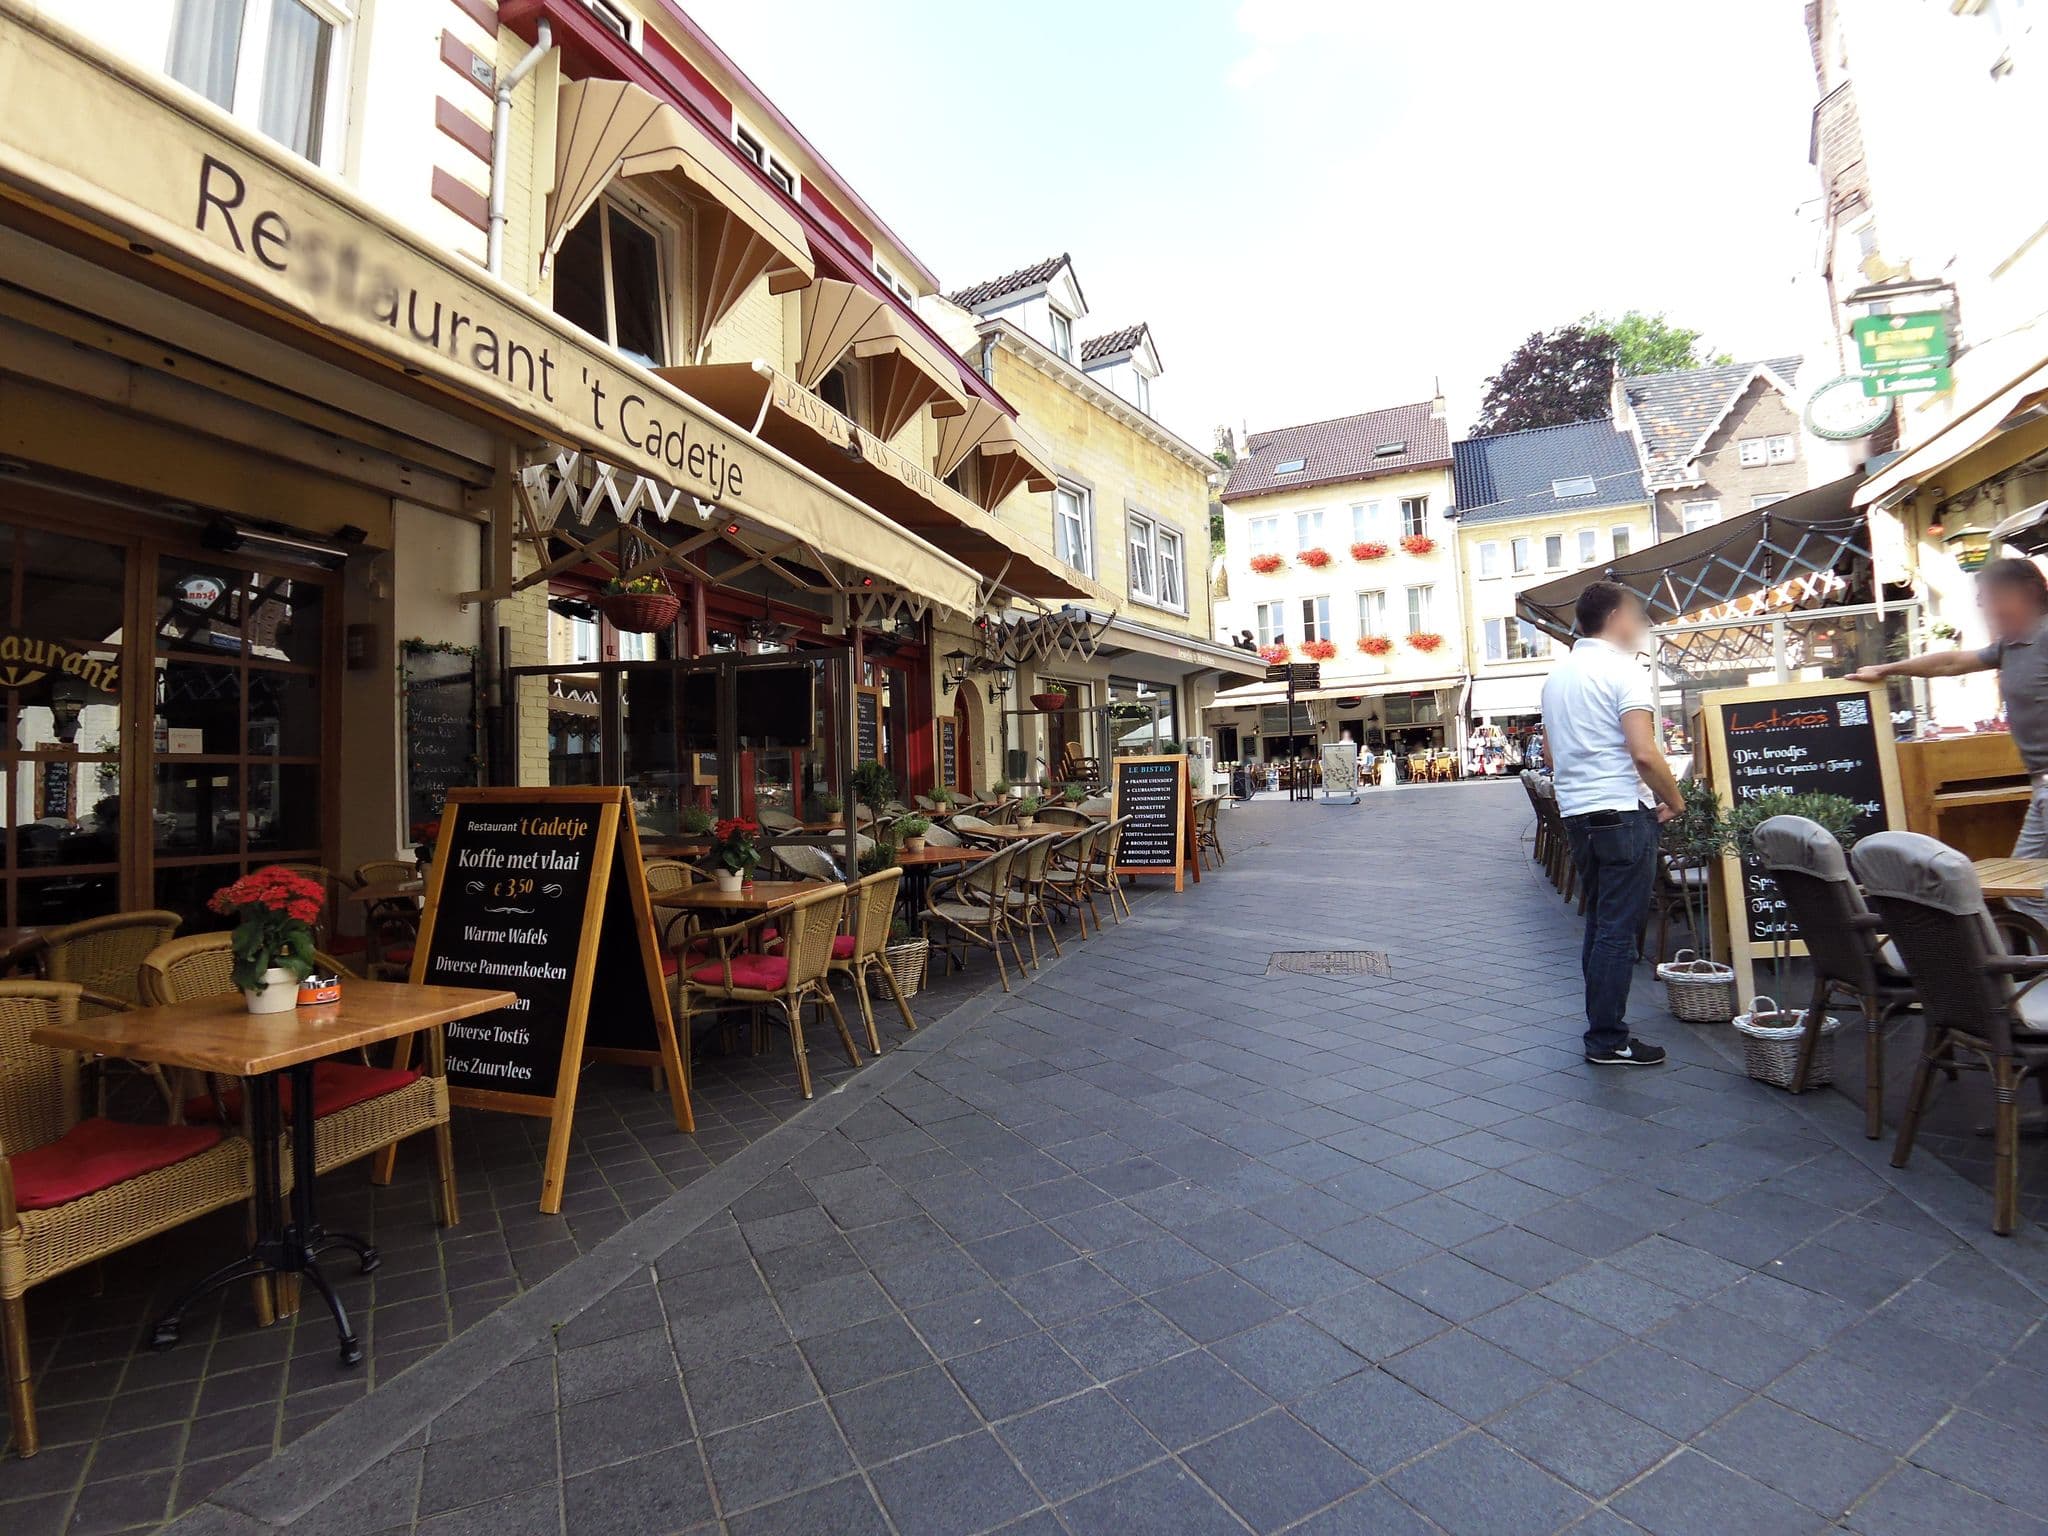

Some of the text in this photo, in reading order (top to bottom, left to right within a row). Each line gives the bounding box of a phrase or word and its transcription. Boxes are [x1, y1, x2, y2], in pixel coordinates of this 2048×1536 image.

[582, 367, 606, 430] 't
[619, 394, 744, 501] Cadetje
[786, 384, 842, 439] PASTA
[900, 460, 937, 499] GRILL
[1730, 707, 1829, 731] Latinos
[1733, 745, 1808, 765] Div. broodjes
[1141, 765, 1171, 773] BISTRO
[1776, 761, 1818, 776] Carpaccio
[467, 817, 588, 841] Restaurant 't Cadetje
[458, 848, 580, 871] Koffie met vlaai
[494, 878, 534, 900] € 3,50
[463, 925, 549, 945] Warme Wafels
[1754, 921, 1799, 937] Saads
[435, 955, 567, 980] Diverse Pannenkoeken
[447, 1021, 530, 1045] Diverse Tosti's
[444, 1055, 533, 1080] ites Zuurvlees
